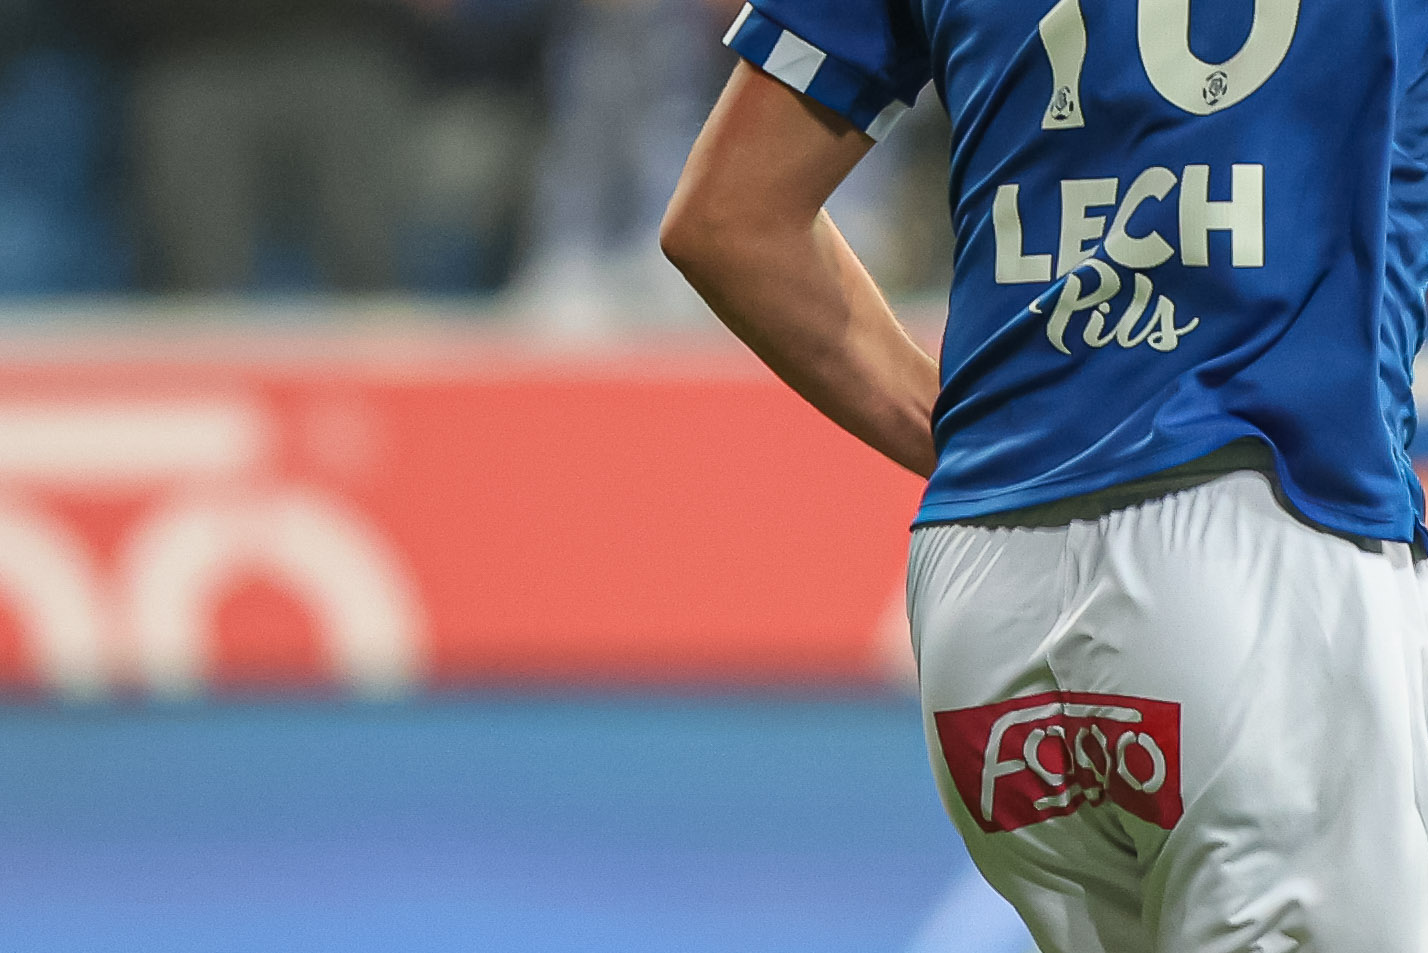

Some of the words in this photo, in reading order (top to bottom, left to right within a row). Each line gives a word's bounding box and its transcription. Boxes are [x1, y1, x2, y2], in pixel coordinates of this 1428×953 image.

[992, 163, 1264, 284] LECH
[1029, 258, 1200, 355] Pils
[980, 702, 1167, 822] Fogo
